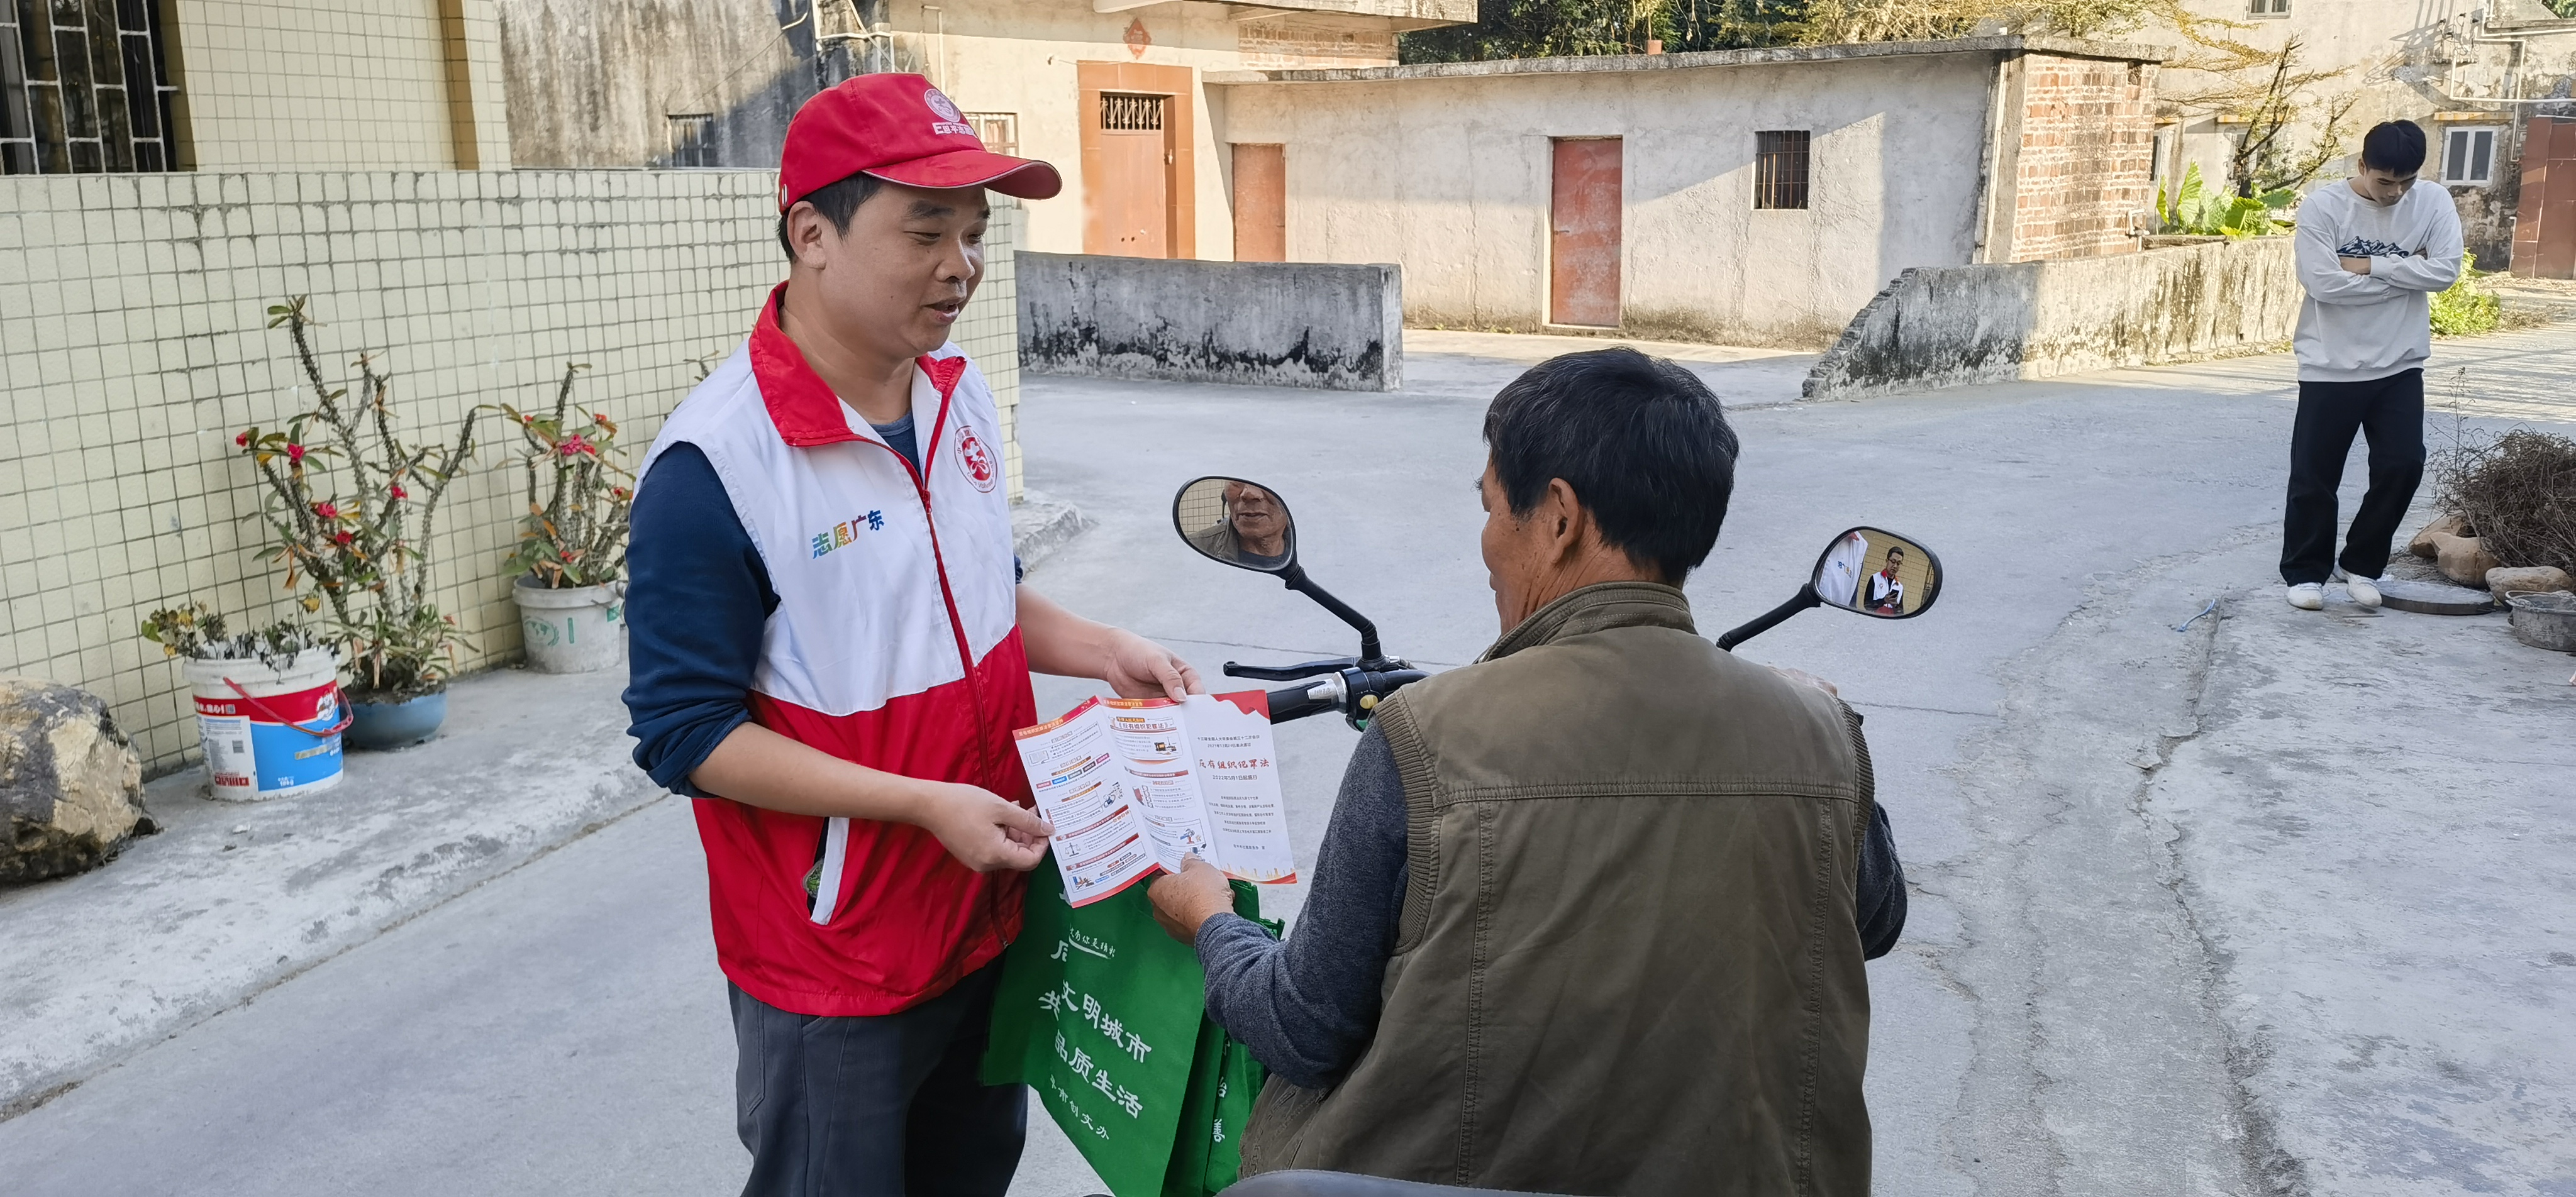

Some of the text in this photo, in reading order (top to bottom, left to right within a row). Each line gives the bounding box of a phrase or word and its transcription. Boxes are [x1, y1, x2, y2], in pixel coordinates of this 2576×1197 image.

[812, 509, 885, 559] 志愿广东
[1199, 758, 1269, 769] 反有组织犯罪法
[1055, 1029, 1143, 1118] 品质生活
